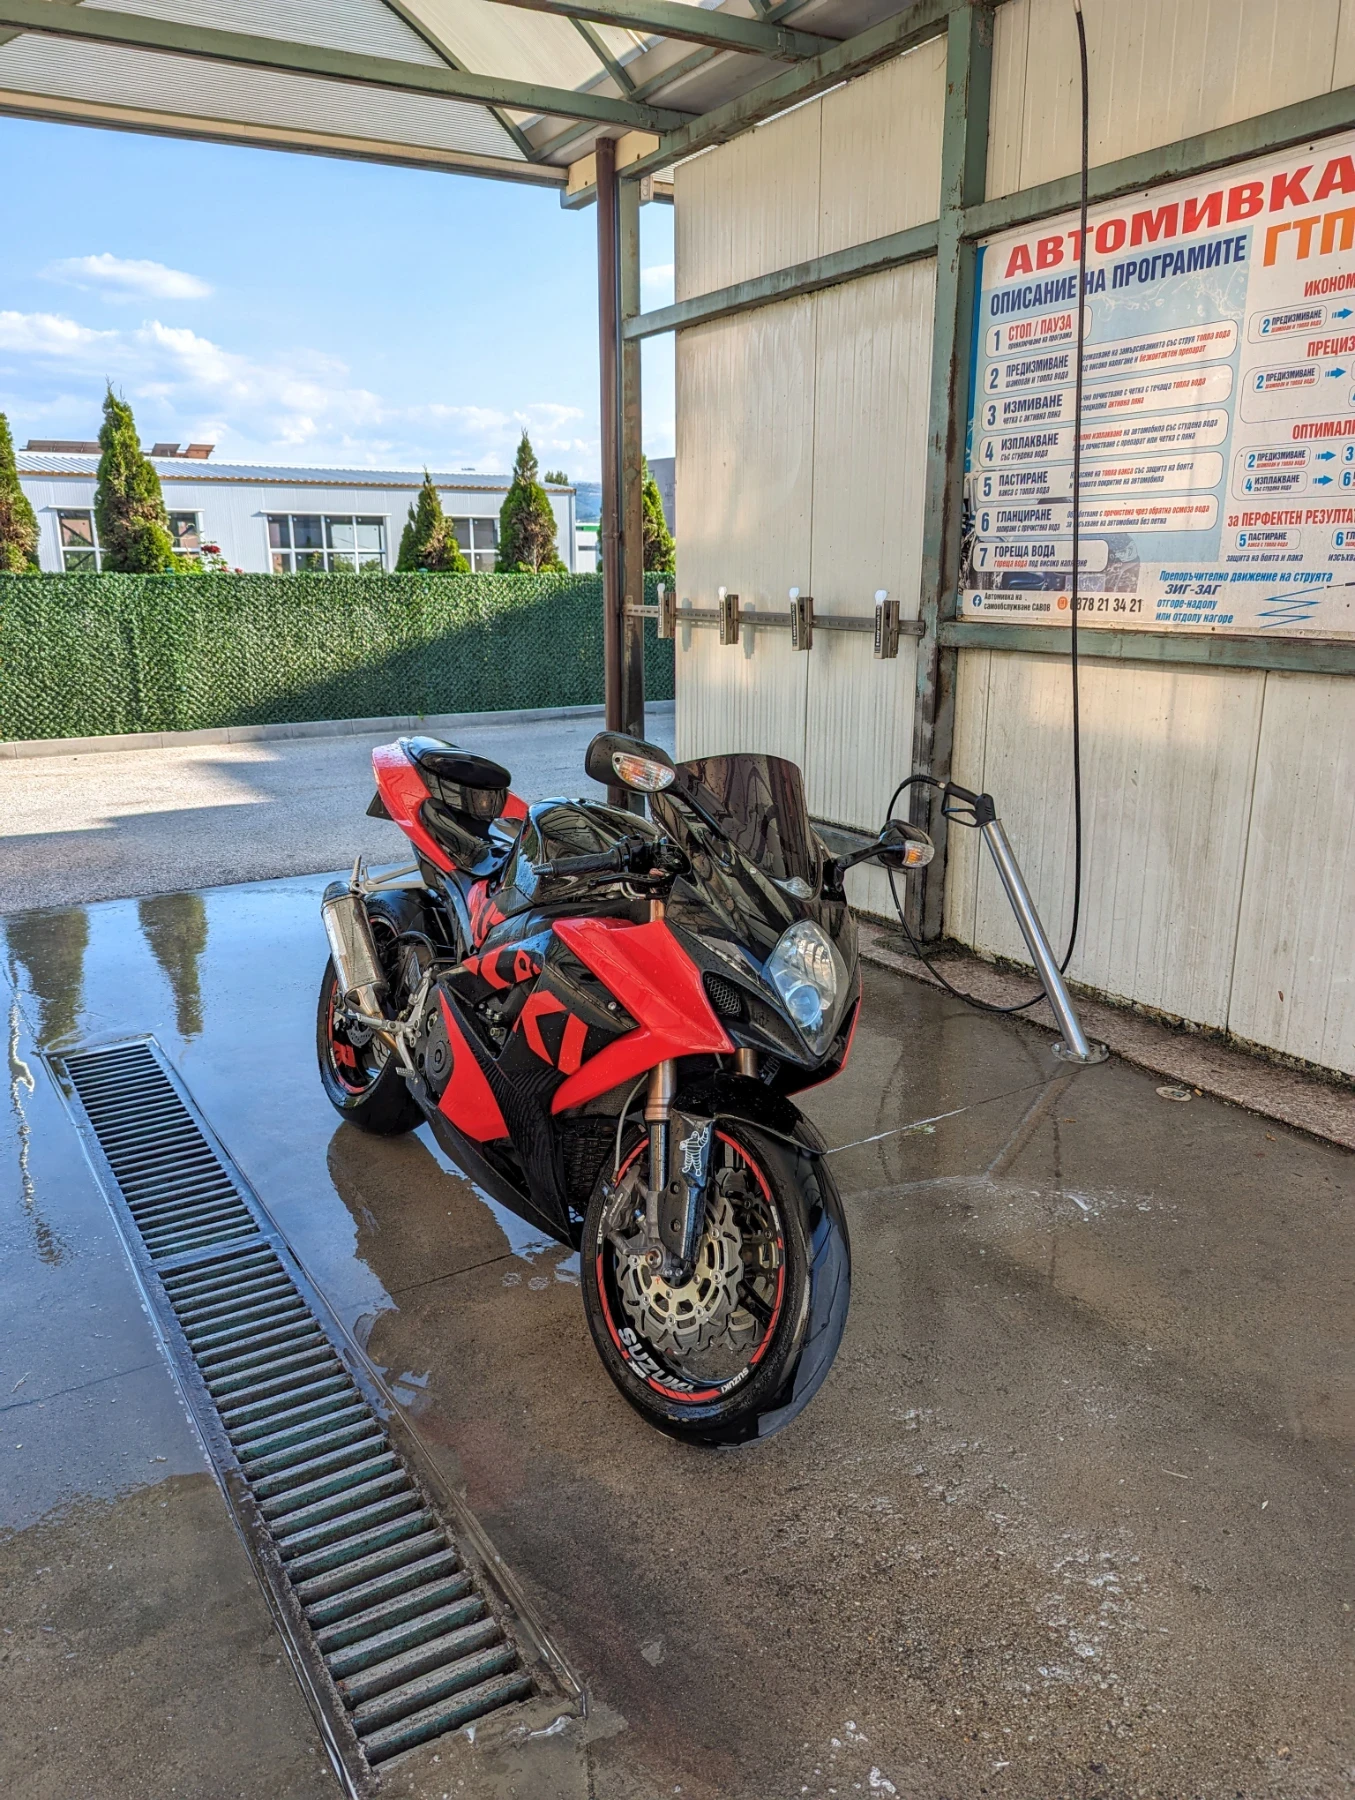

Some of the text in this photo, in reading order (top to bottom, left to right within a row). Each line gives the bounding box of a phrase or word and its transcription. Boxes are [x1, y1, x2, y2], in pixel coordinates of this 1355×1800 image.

[1004, 155, 1355, 279] АВТОМИВКА
[990, 234, 1248, 317] ОПИСАНИЕ НА ПРОГРАМИТЕ
[1271, 309, 1323, 326] ПРЕДИЗМИВАНЕ
[1008, 321, 1033, 342] СТОП
[1040, 313, 1072, 336] ПАУЗА
[1262, 318, 1271, 334] 2
[993, 329, 1001, 352] 1
[1005, 354, 1070, 379] ПРЕДИЗМИВАНЕ
[989, 367, 1000, 390] 2
[1256, 374, 1265, 390] 2
[1265, 367, 1316, 383] ПРЕДИЗМИВАНЕ
[1003, 393, 1064, 415] ИЗМИВАНЕ
[987, 404, 997, 426] 3
[1001, 432, 1059, 452] ИЗПЛАКВАНЕ
[984, 441, 994, 462] 4
[1256, 449, 1307, 462] ПРЕДИЗМИВАНЕ
[1345, 446, 1355, 461] 3
[1247, 453, 1256, 469] 2
[983, 476, 992, 497] 5
[998, 470, 1049, 487] ПАСТИРАНЕ
[1245, 478, 1253, 492] 4
[1254, 474, 1300, 485] ИЗПЛАКВАНЕ
[1342, 471, 1352, 486] 6
[981, 511, 990, 532] 6
[996, 508, 1052, 524] ГЛАНЦИРАНЕ
[1227, 515, 1239, 528] за
[1241, 509, 1304, 527] ПЕРФЕКТЕН
[1238, 533, 1247, 547] 5
[1248, 532, 1288, 541] ПАСТИРАНЕ
[1335, 531, 1344, 546] 6
[979, 547, 988, 567] 7
[994, 544, 1056, 559] ГОРЕЩА ВОДА
[1250, 553, 1259, 561] на
[1159, 570, 1333, 584] Препоръчително движение на струята
[1164, 583, 1222, 596] ЗИГ-ЗАГ
[1031, 603, 1051, 612] САВОВ
[1097, 598, 1109, 612] 21
[1113, 598, 1127, 612] 34
[1129, 599, 1143, 613] 21
[1156, 598, 1218, 611] отгоре-надолу
[1155, 612, 1234, 624] или отдолу нагоре
[618, 1327, 695, 1394] SUZUKI
[720, 1366, 749, 1394] SUZUKI
